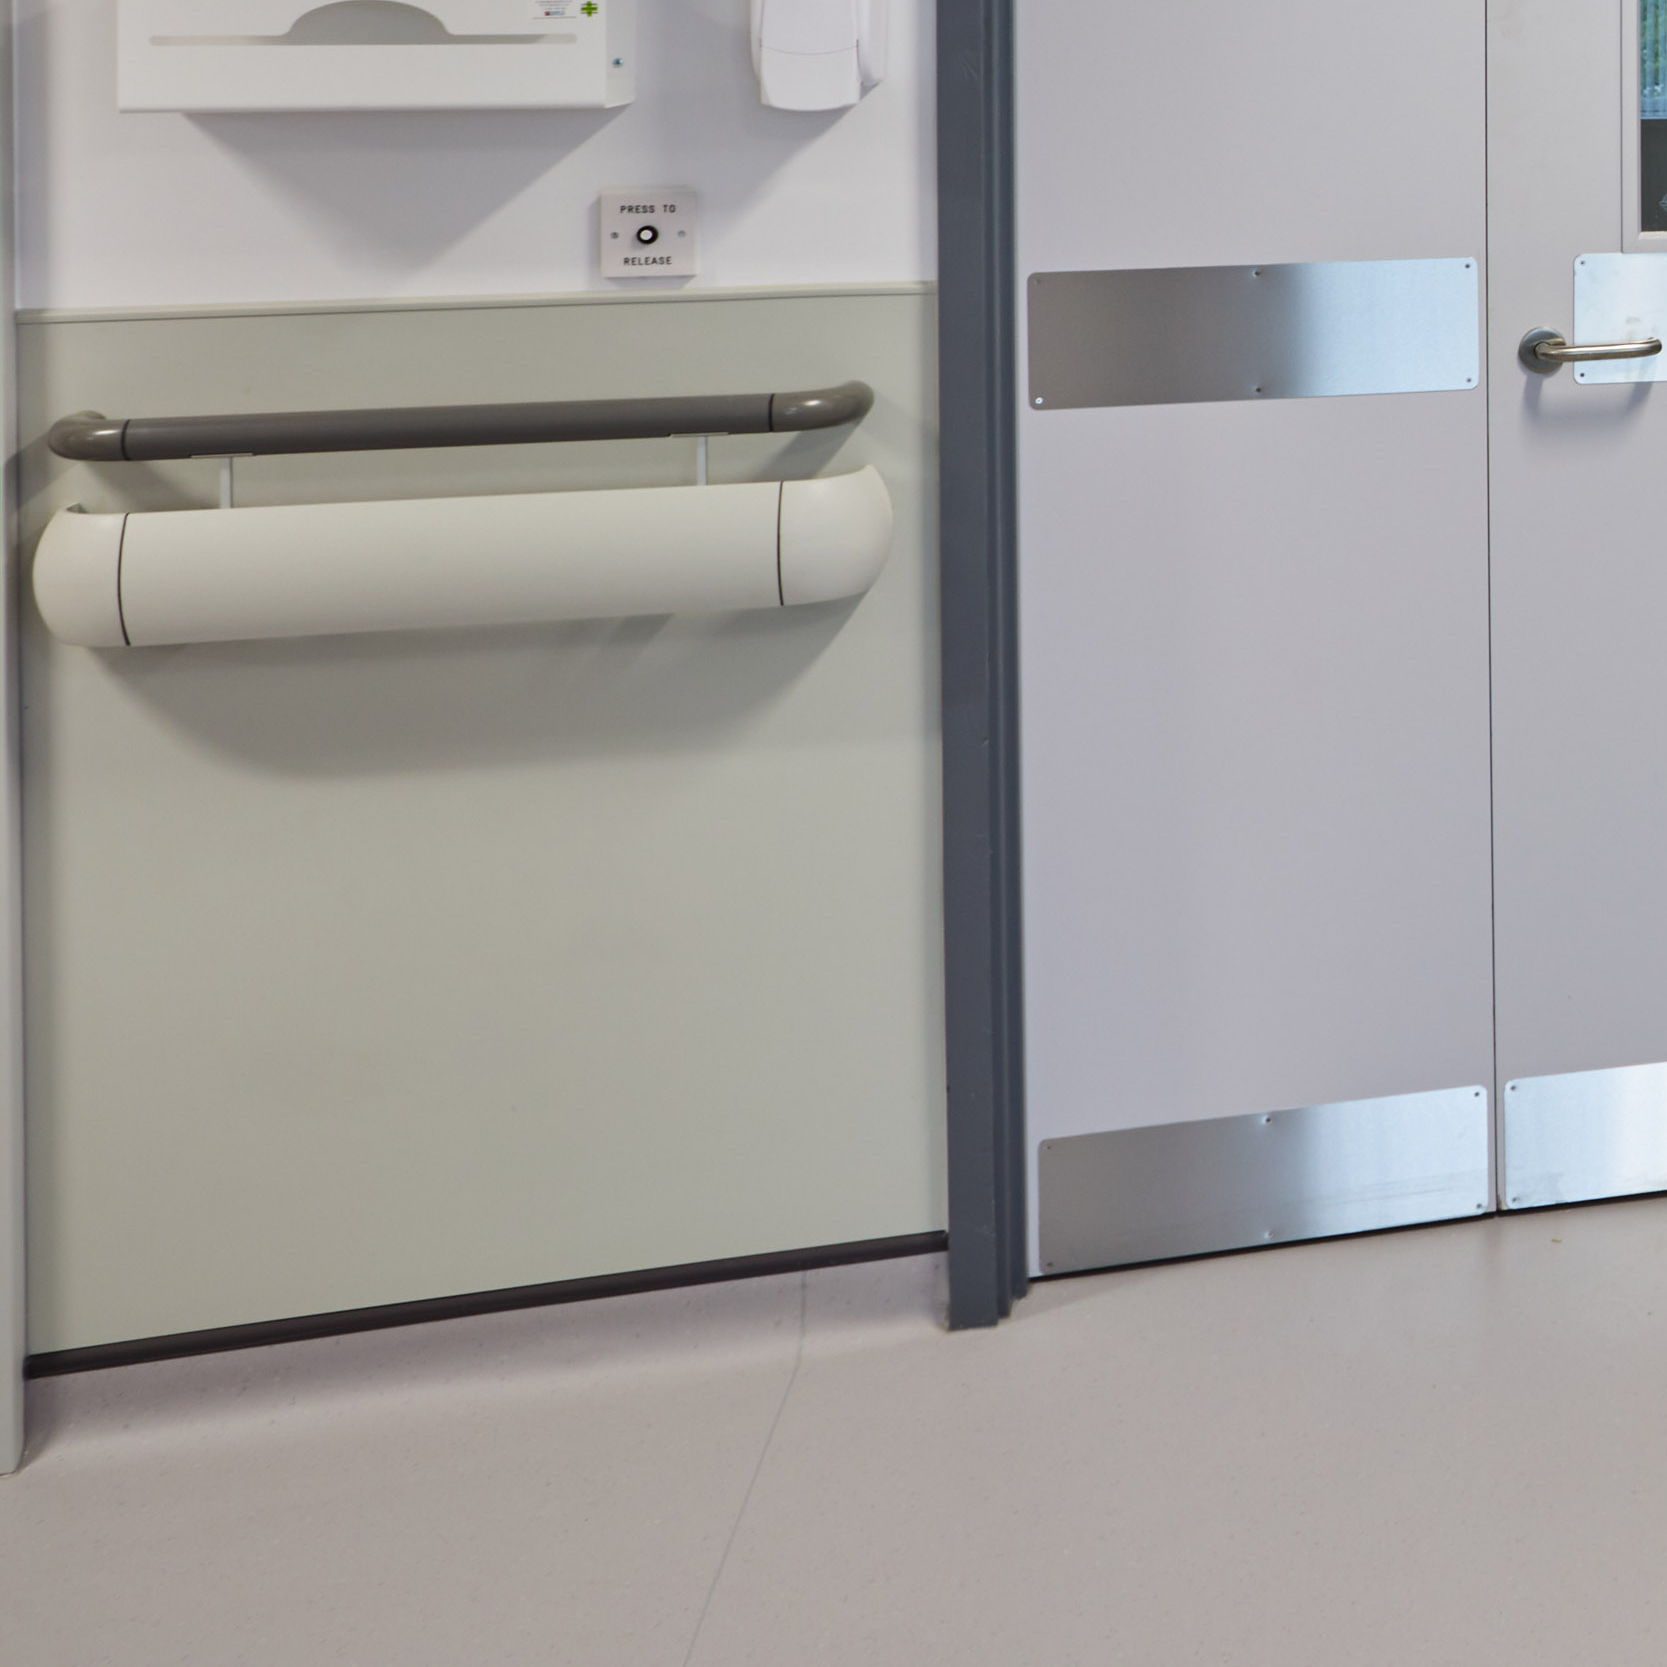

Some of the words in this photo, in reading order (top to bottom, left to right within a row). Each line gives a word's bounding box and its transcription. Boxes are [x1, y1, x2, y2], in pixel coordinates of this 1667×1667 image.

[620, 205, 655, 214] PRESS
[663, 204, 676, 213] TO
[623, 256, 672, 266] RELEASE
